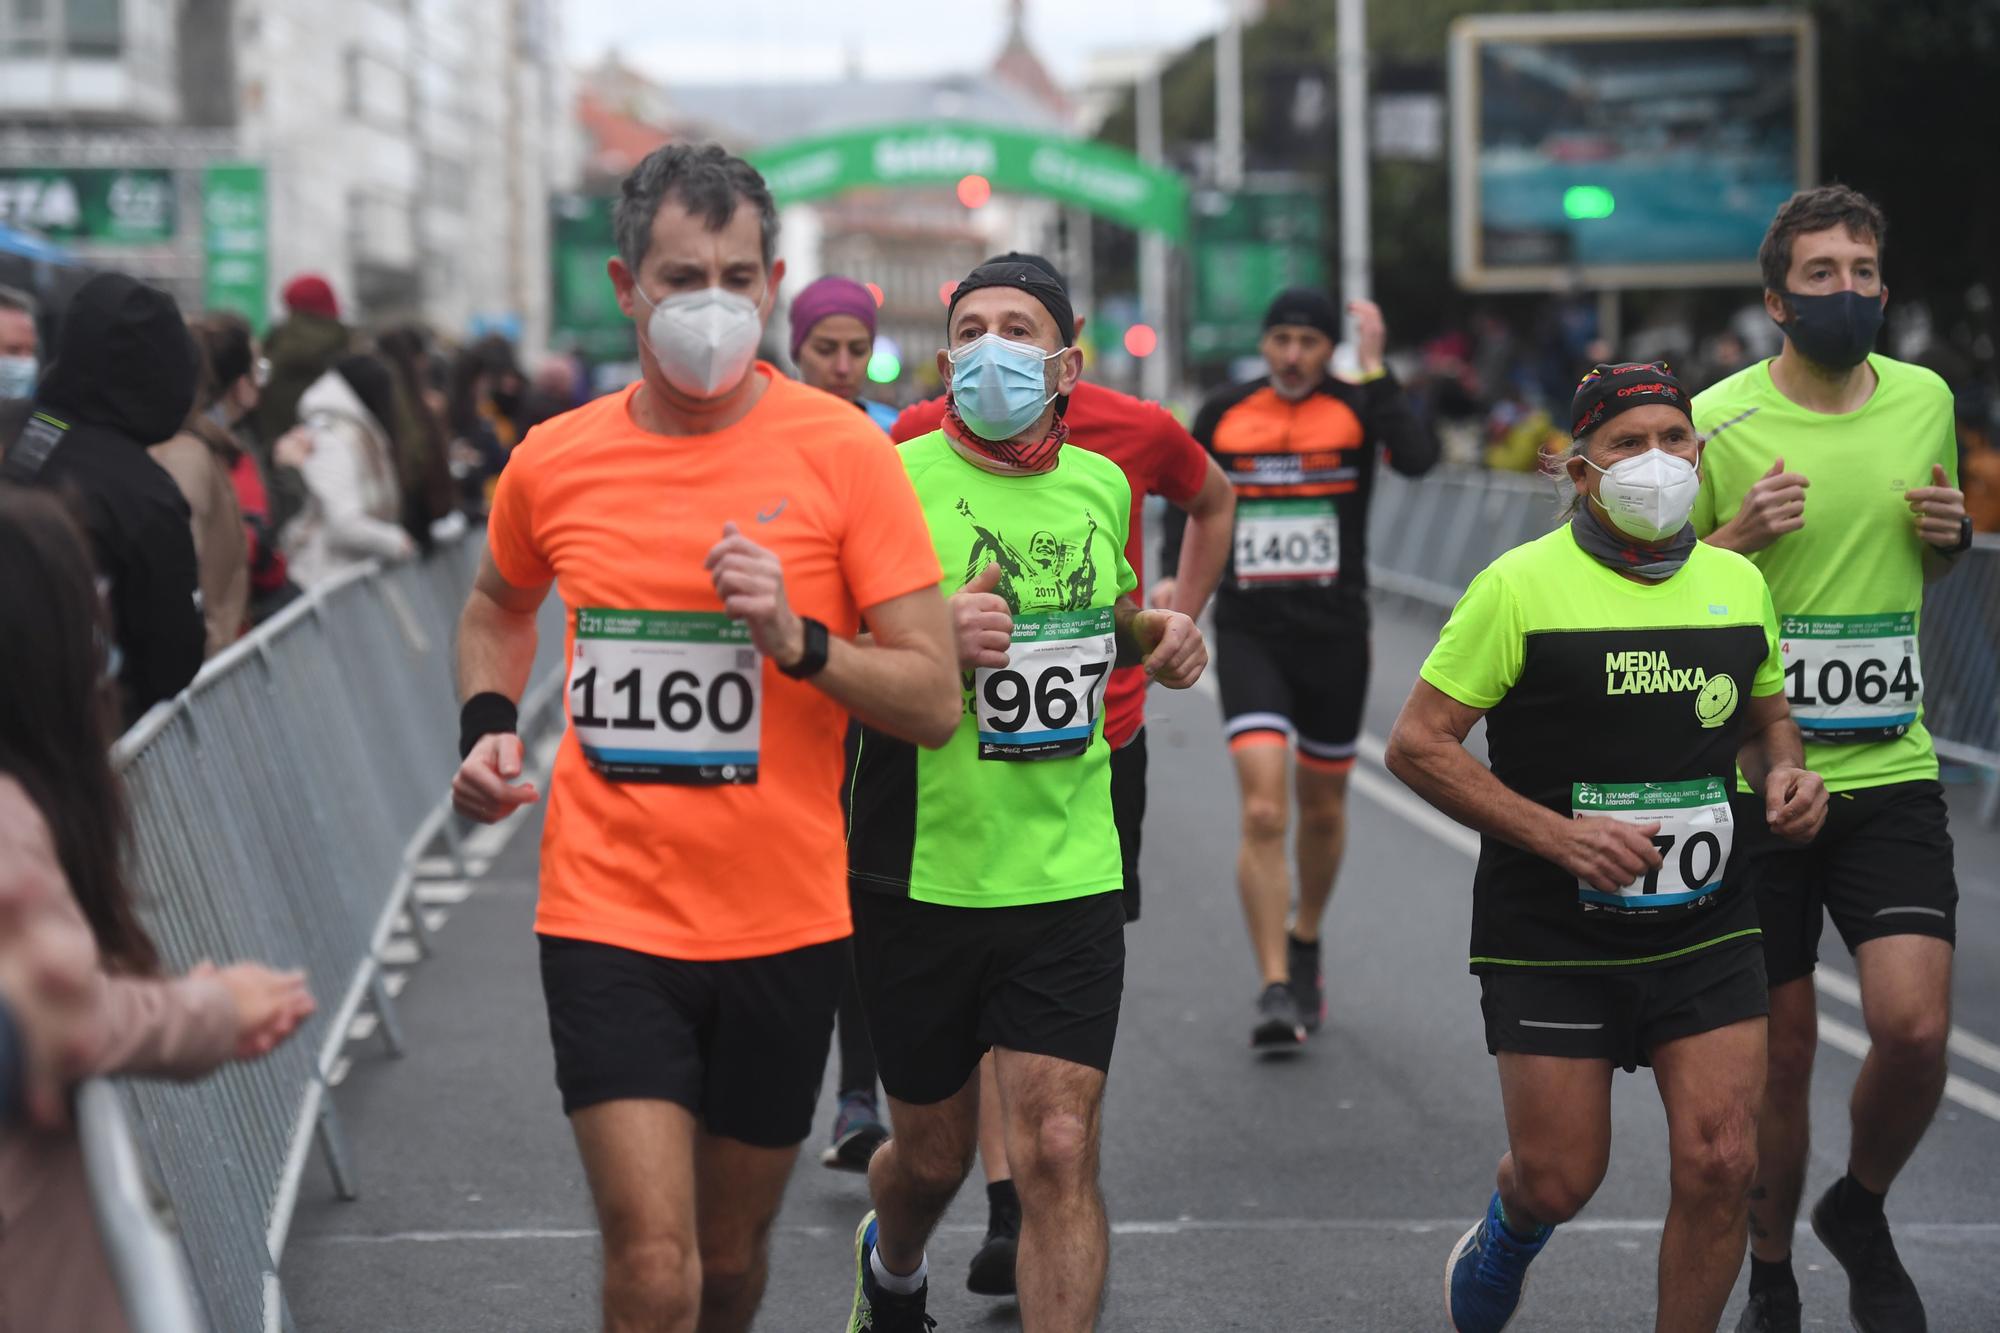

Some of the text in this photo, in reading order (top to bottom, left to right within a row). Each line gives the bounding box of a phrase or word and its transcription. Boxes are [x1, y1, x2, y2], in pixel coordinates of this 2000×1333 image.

[1239, 530, 1331, 565] 1403
[1035, 587, 1056, 597] 2017
[1786, 622, 1809, 634] C21
[1782, 642, 1790, 654] 4
[1605, 650, 1671, 673] MEDIA
[1606, 667, 1708, 695] LARANXA
[1784, 656, 1919, 706] 1064
[572, 666, 753, 733] 1160
[984, 661, 1108, 733] 967
[1578, 791, 1603, 805] C21
